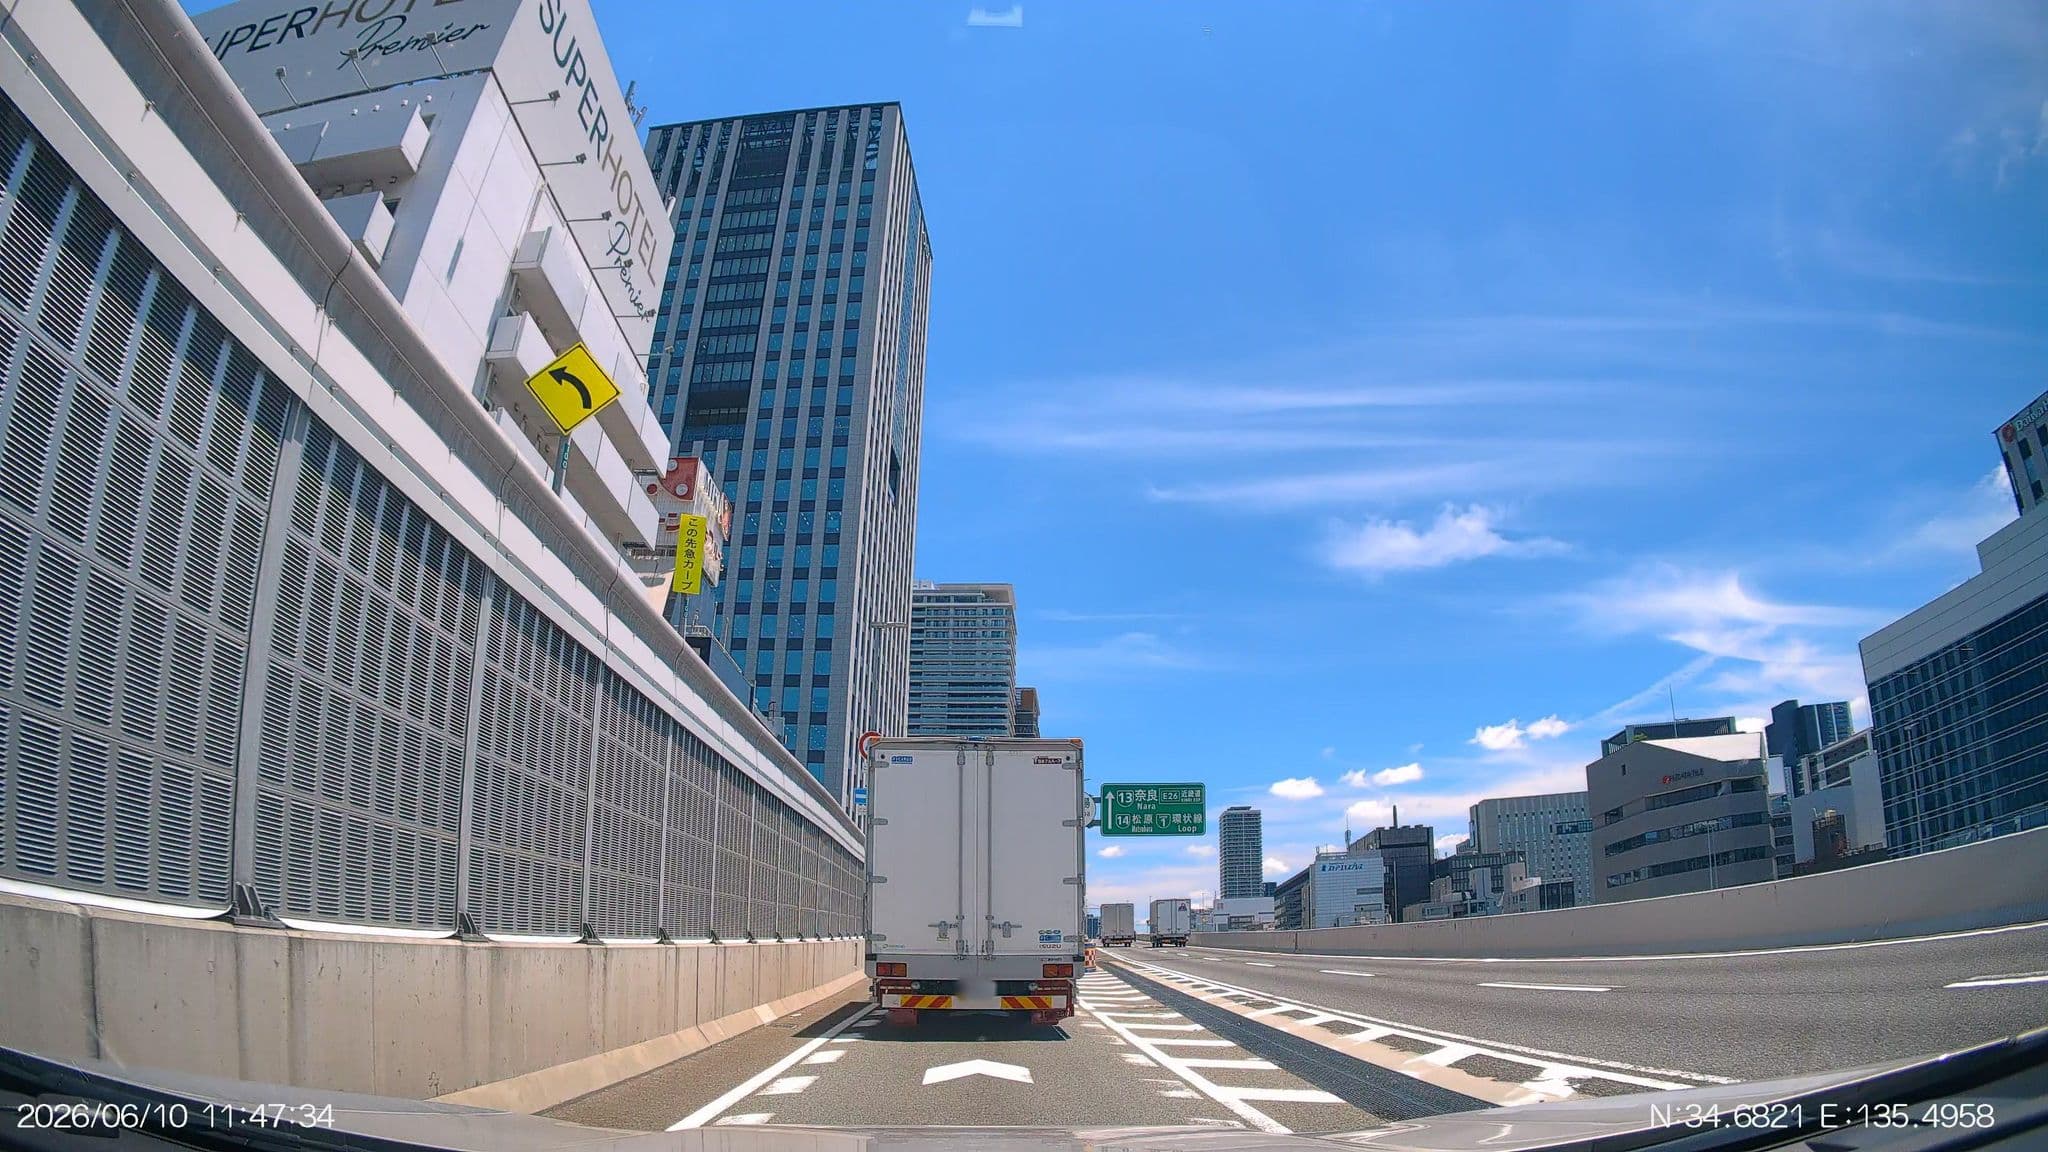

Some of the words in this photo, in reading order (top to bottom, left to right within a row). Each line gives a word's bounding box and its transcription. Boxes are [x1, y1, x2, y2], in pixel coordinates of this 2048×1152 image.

[204, 0, 464, 61] UPERHO
[336, 14, 491, 70] Premier
[606, 221, 652, 323] Premier
[681, 517, 698, 591] この先急カーブ
[1118, 792, 1132, 803] 13
[1134, 789, 1158, 802] 奈良
[1163, 792, 1178, 800] E26
[1117, 816, 1129, 825] 14
[1132, 813, 1153, 824] 松原
[1172, 813, 1203, 824] 環状線
[1178, 824, 1197, 833] Loop
